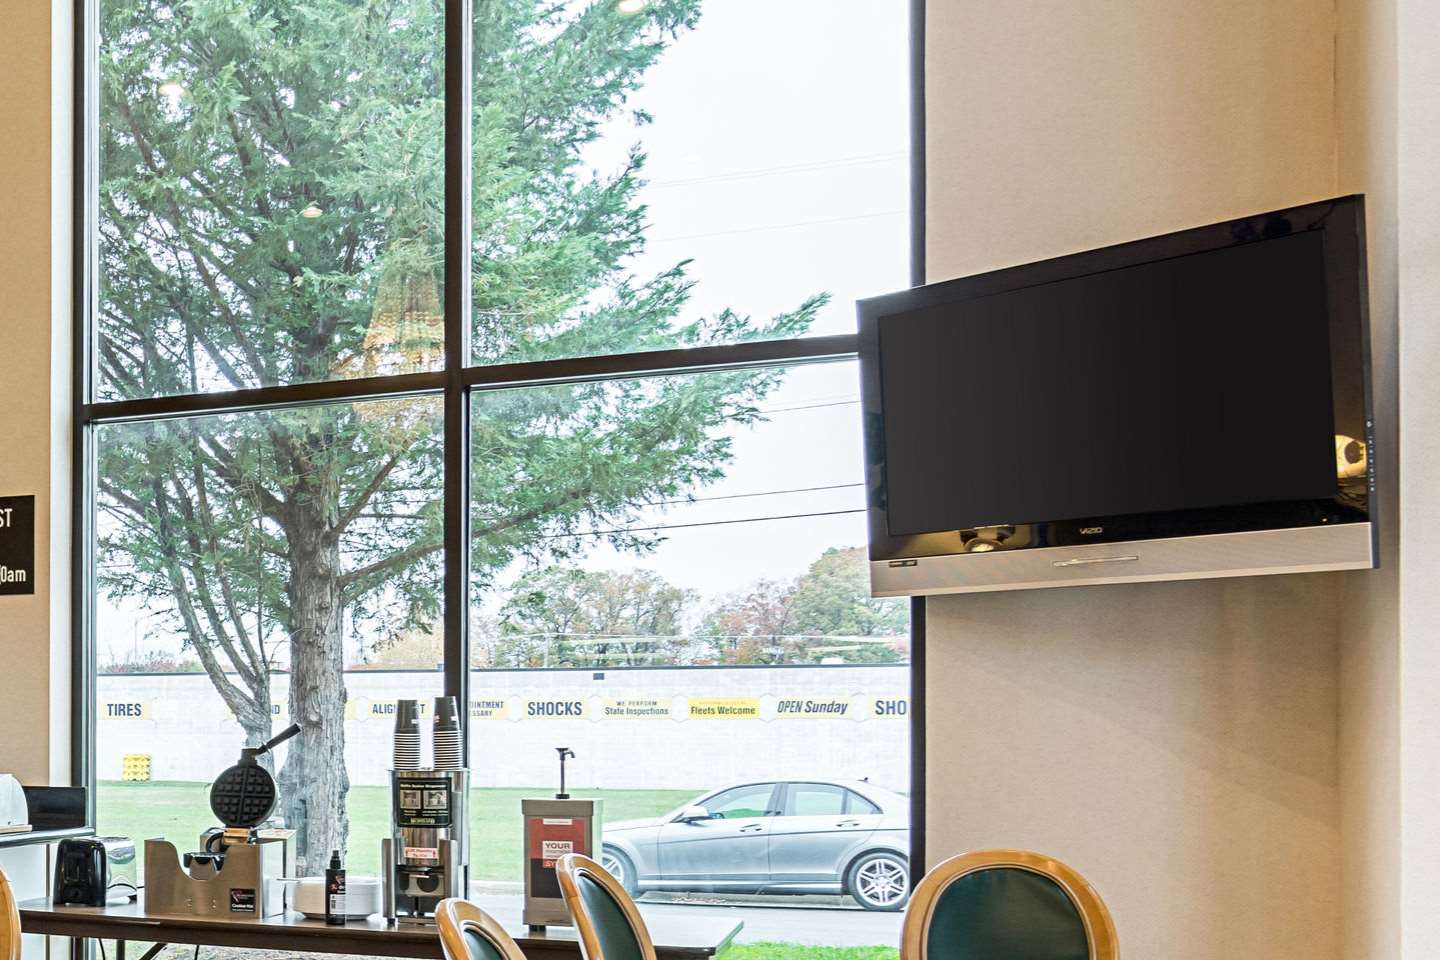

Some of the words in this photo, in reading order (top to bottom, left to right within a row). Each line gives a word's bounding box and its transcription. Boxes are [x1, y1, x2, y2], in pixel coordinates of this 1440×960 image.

[106, 703, 142, 717] TIRES
[527, 701, 583, 716] SHOCKS
[605, 706, 625, 715] State
[626, 706, 669, 717] Inspections
[690, 706, 715, 715] Fleets
[717, 706, 756, 715] Welcome
[777, 700, 803, 713] OPEN
[804, 700, 848, 715] Sunday
[874, 700, 907, 716] SHO
